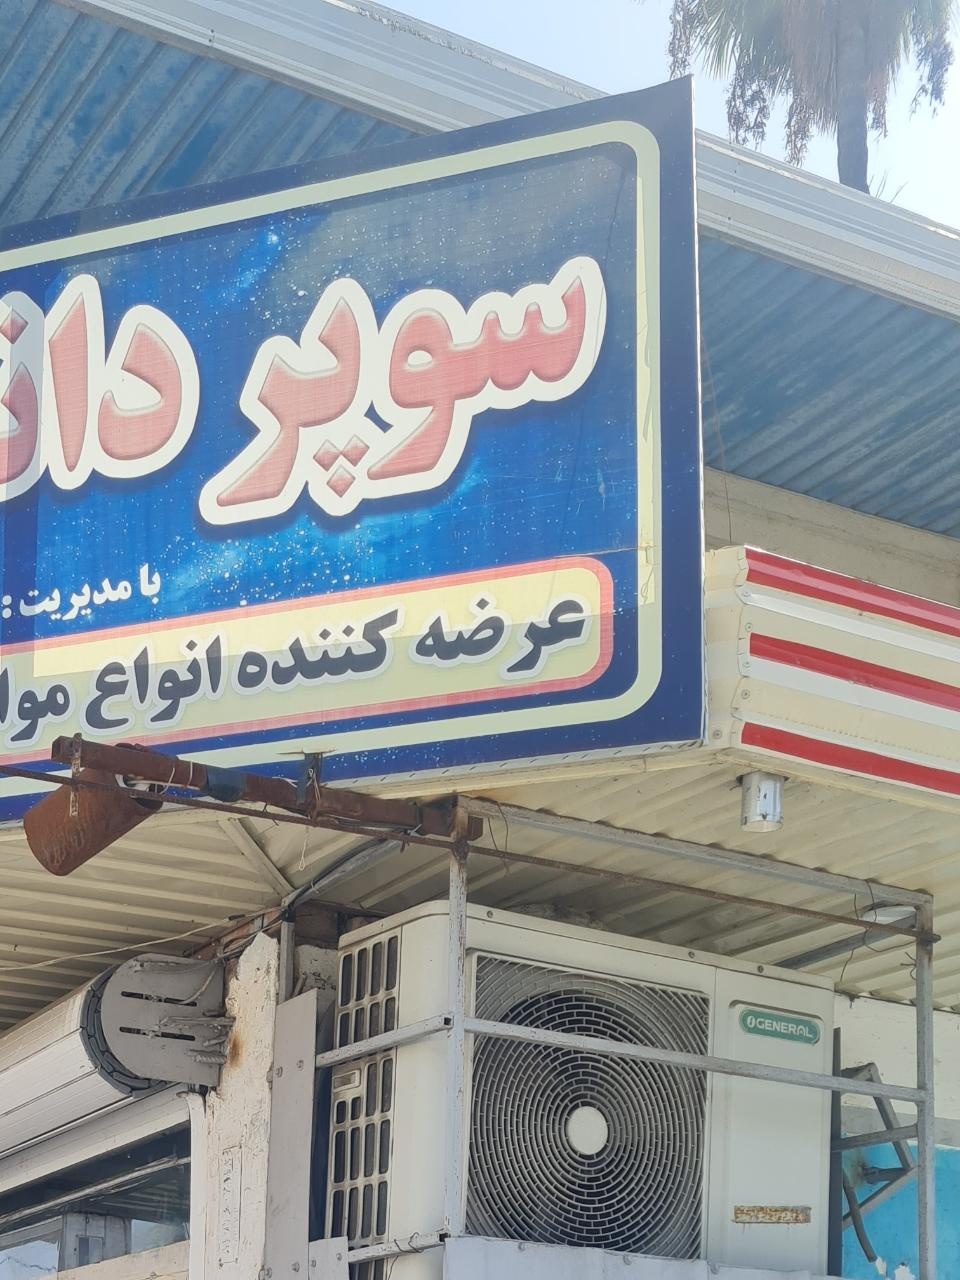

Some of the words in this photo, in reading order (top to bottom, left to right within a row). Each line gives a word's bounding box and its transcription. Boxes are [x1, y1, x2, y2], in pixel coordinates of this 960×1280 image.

[198, 257, 606, 525] سوپر
[19, 577, 132, 620] مدیریت
[139, 563, 161, 604] با
[238, 608, 399, 689] کننده
[415, 596, 586, 673] عرضه
[84, 635, 222, 730] انواع
[756, 1018, 814, 1038] GENERAL
